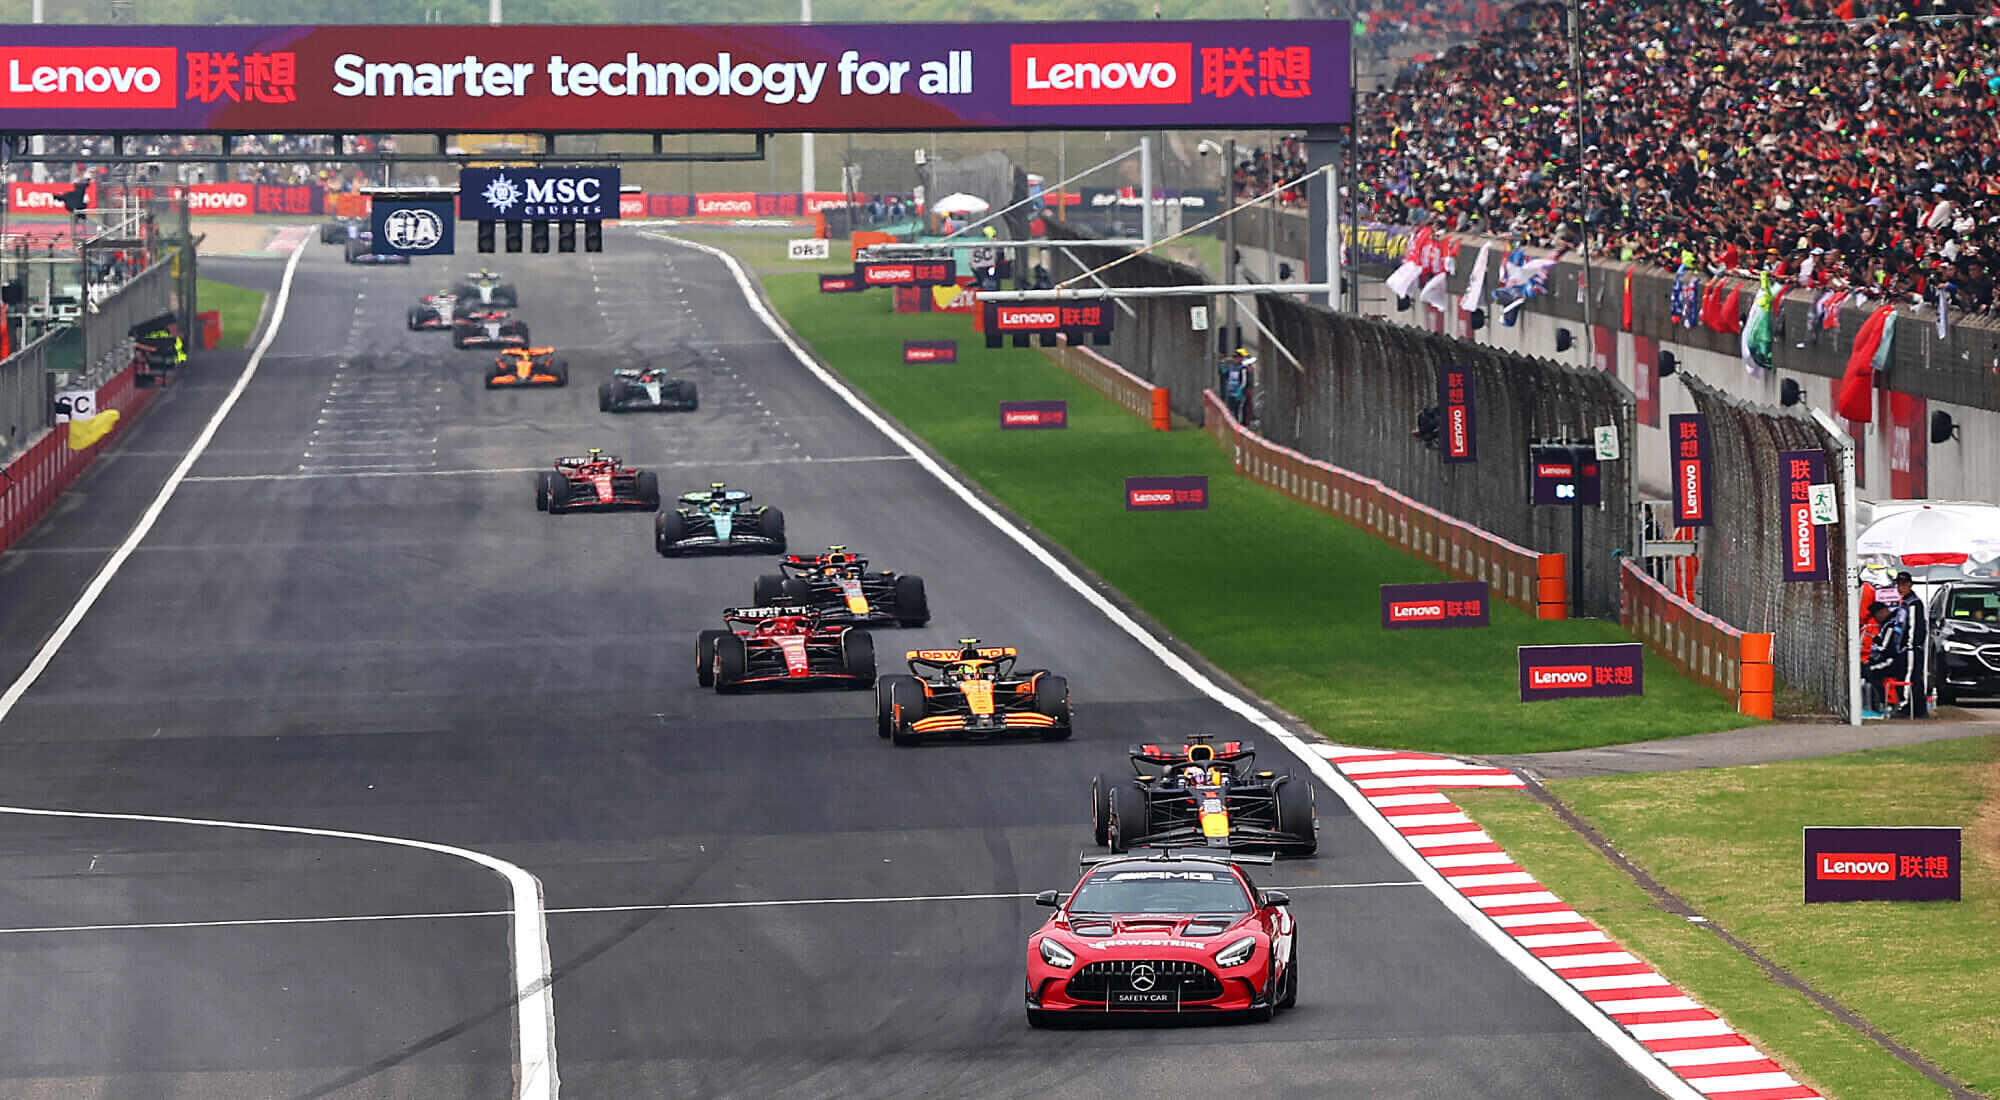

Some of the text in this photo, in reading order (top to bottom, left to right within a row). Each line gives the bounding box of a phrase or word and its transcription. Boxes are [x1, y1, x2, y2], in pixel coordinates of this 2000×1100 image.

[8, 51, 296, 104] Lenovo 联想
[332, 50, 972, 104] Smarter technology for all
[1026, 46, 1312, 98] Lenovo 联想
[524, 177, 601, 204] MSC
[1002, 311, 1055, 324] Lenovo
[1453, 409, 1464, 453] Lenovo
[1679, 422, 1699, 458] 联想
[1685, 464, 1698, 515] Lenovo
[1790, 459, 1811, 501] 联想
[1796, 508, 1811, 567] Lenovo
[1394, 600, 1481, 617] Lenovo 联想
[1534, 666, 1633, 685] Lenovo 联想
[1823, 855, 1949, 879] Lenovo 联想
[1119, 994, 1168, 1002] SAFETY CAR
